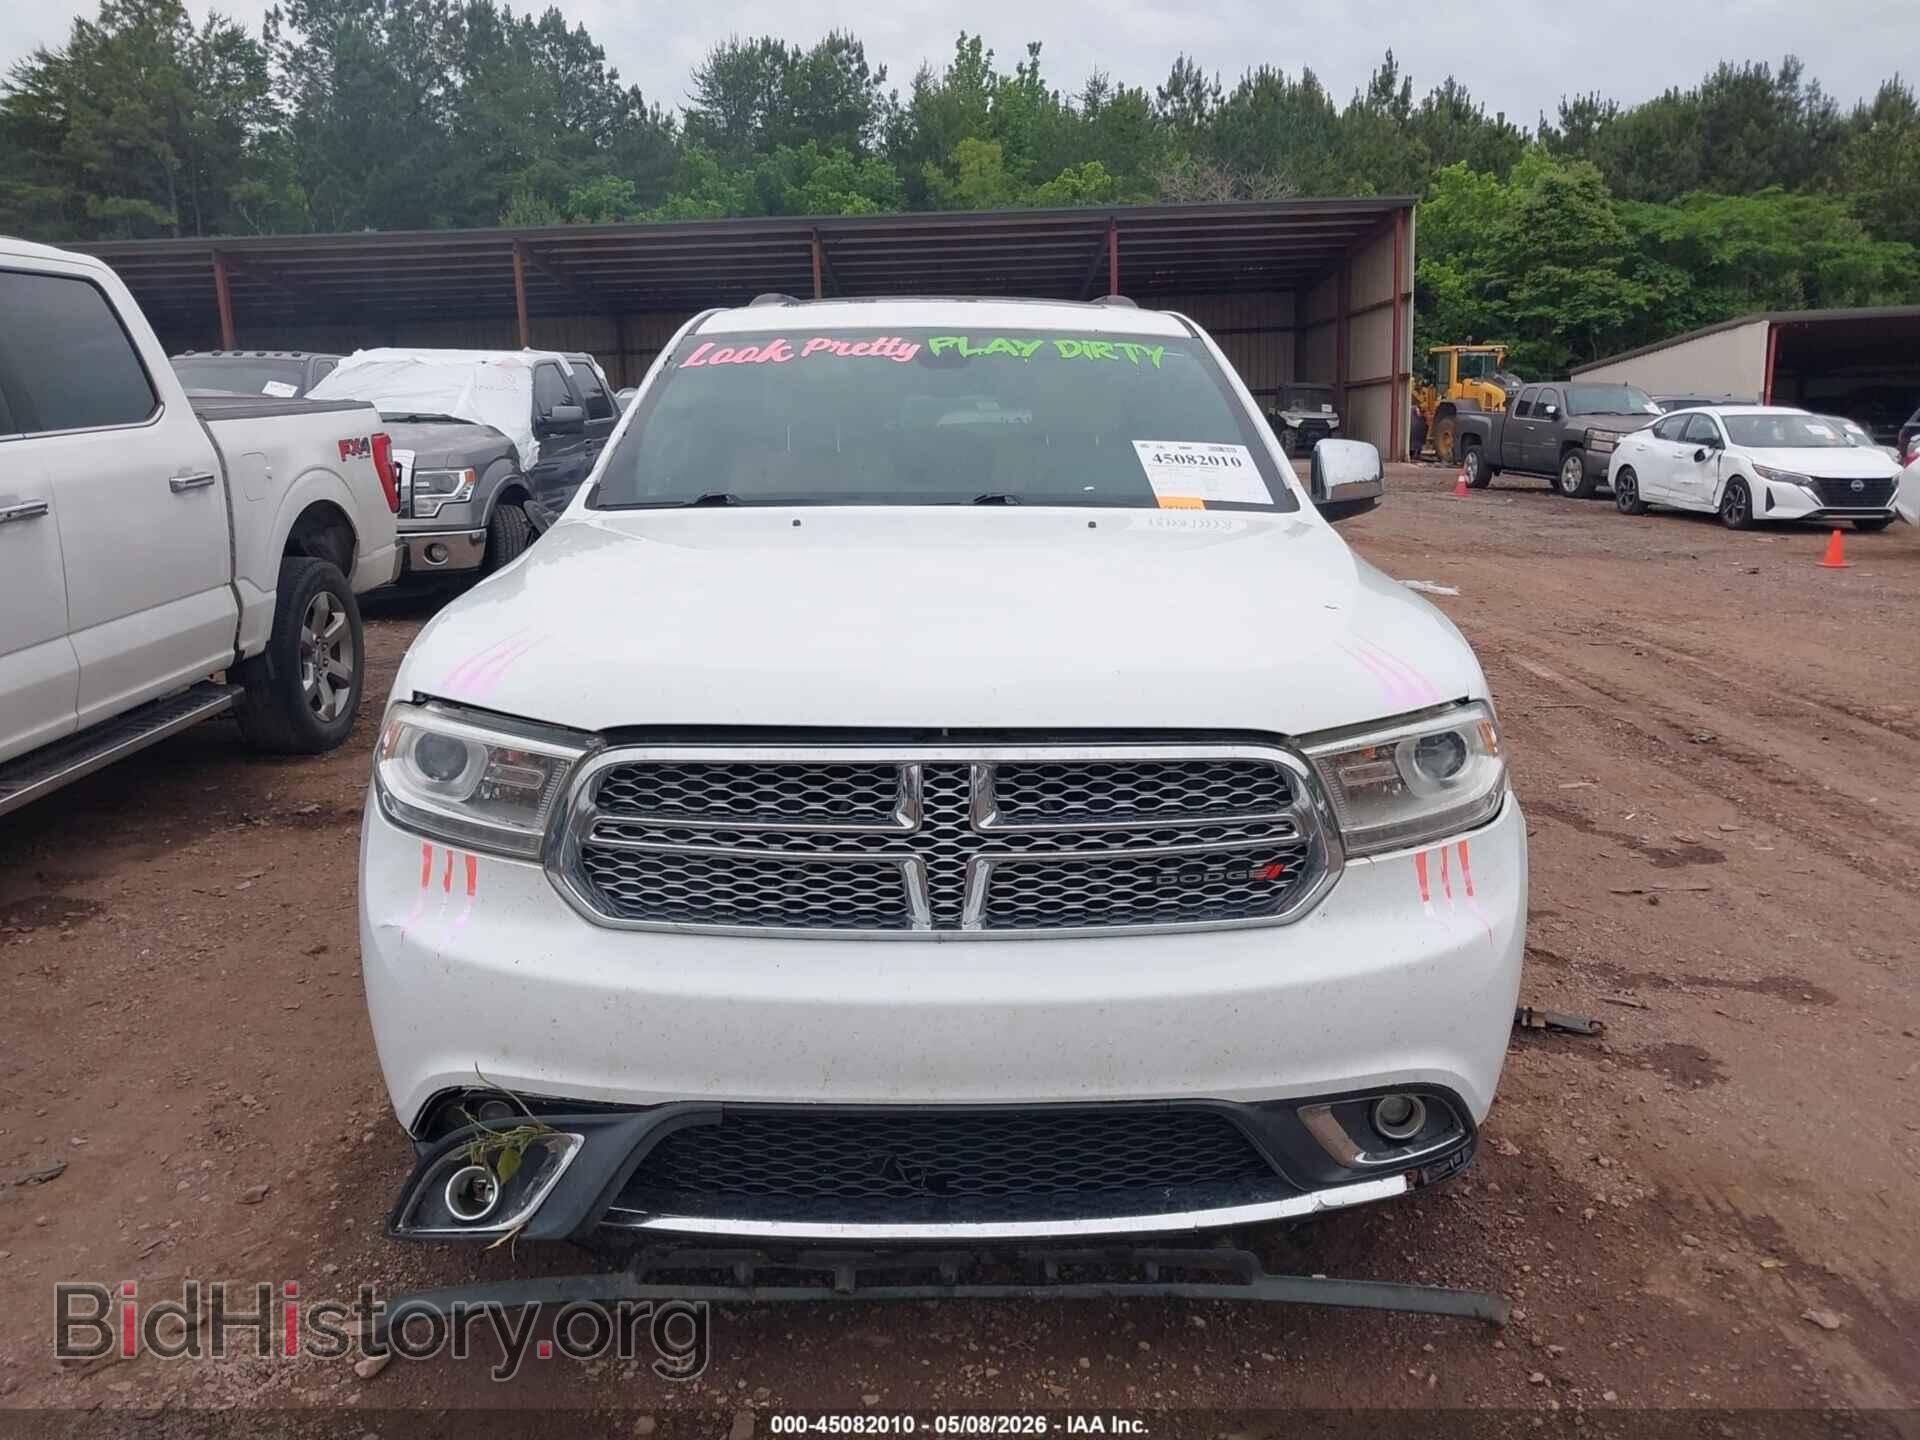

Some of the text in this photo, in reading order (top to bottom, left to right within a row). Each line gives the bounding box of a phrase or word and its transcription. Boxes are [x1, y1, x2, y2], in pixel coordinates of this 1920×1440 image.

[800, 337, 921, 362] Pretty
[928, 336, 1044, 362] PLAY
[338, 436, 371, 462] FX4
[1152, 453, 1242, 468] 45082010
[1156, 869, 1268, 886] DODGE
